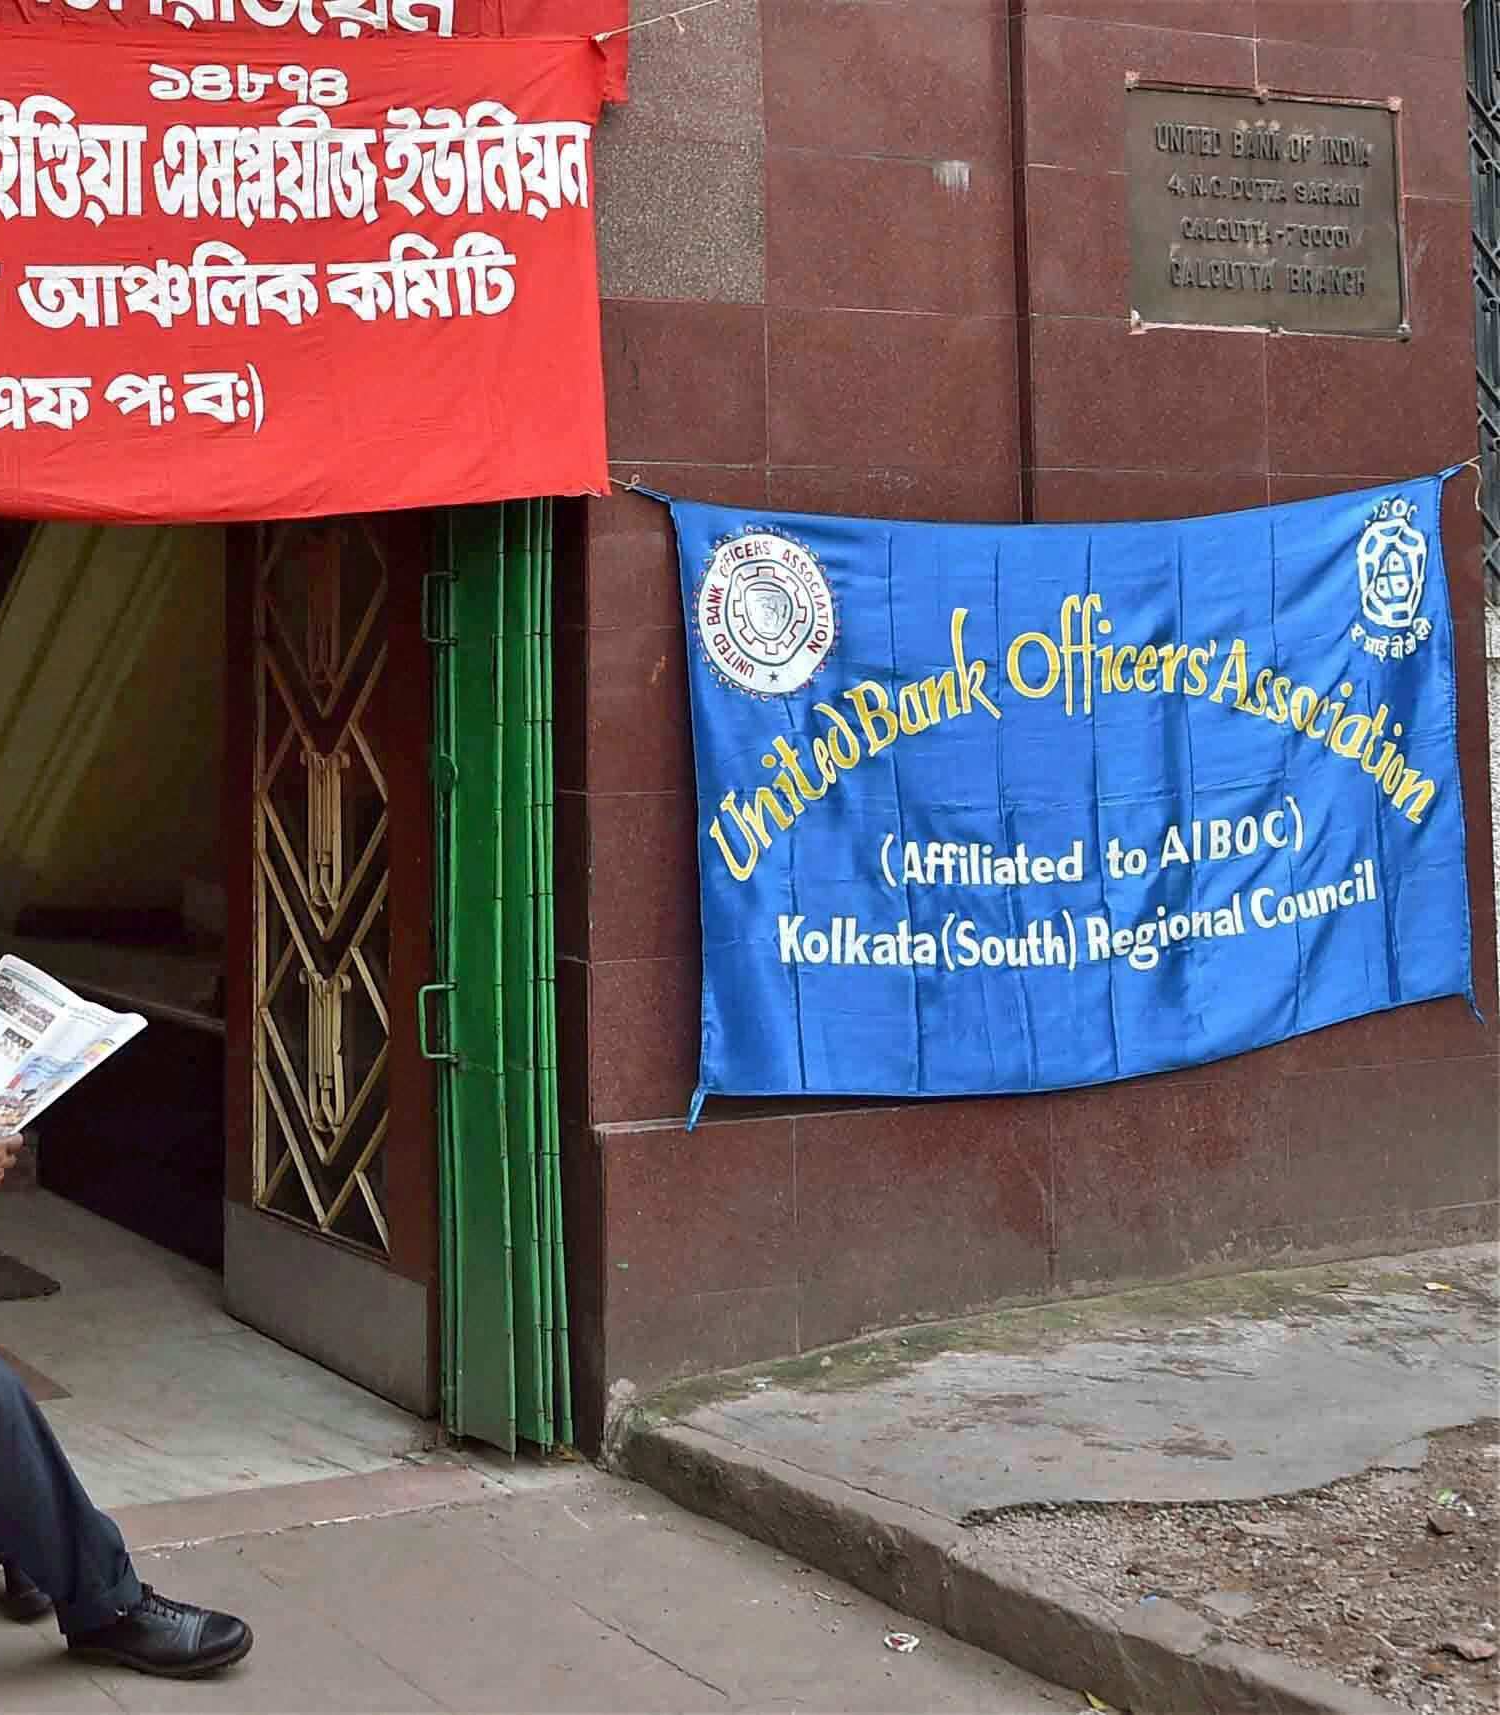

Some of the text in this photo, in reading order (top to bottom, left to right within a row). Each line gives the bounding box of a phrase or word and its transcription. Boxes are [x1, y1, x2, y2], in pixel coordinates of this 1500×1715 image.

[149, 63, 349, 106] ১৪৮৭৪
[382, 100, 592, 221] ইউনিয়ন
[1155, 122, 1373, 168] UNITED BANK OF INDIA
[1292, 180, 1364, 208] SARANI
[17, 240, 319, 329] আঞ্চলিক
[326, 231, 516, 321] কমিটি
[1170, 256, 1366, 297] CALCUTTA BRANCH
[706, 584, 725, 626] BANK
[782, 548, 829, 655] ASSOCIATION
[713, 633, 755, 679] UNITED
[709, 702, 861, 881] United
[844, 608, 1002, 757] Bank
[1208, 638, 1437, 824] Association
[881, 796, 1304, 888] (Affiliated to AIBOC)
[1085, 892, 1246, 971] Regional
[1251, 858, 1377, 929] Council
